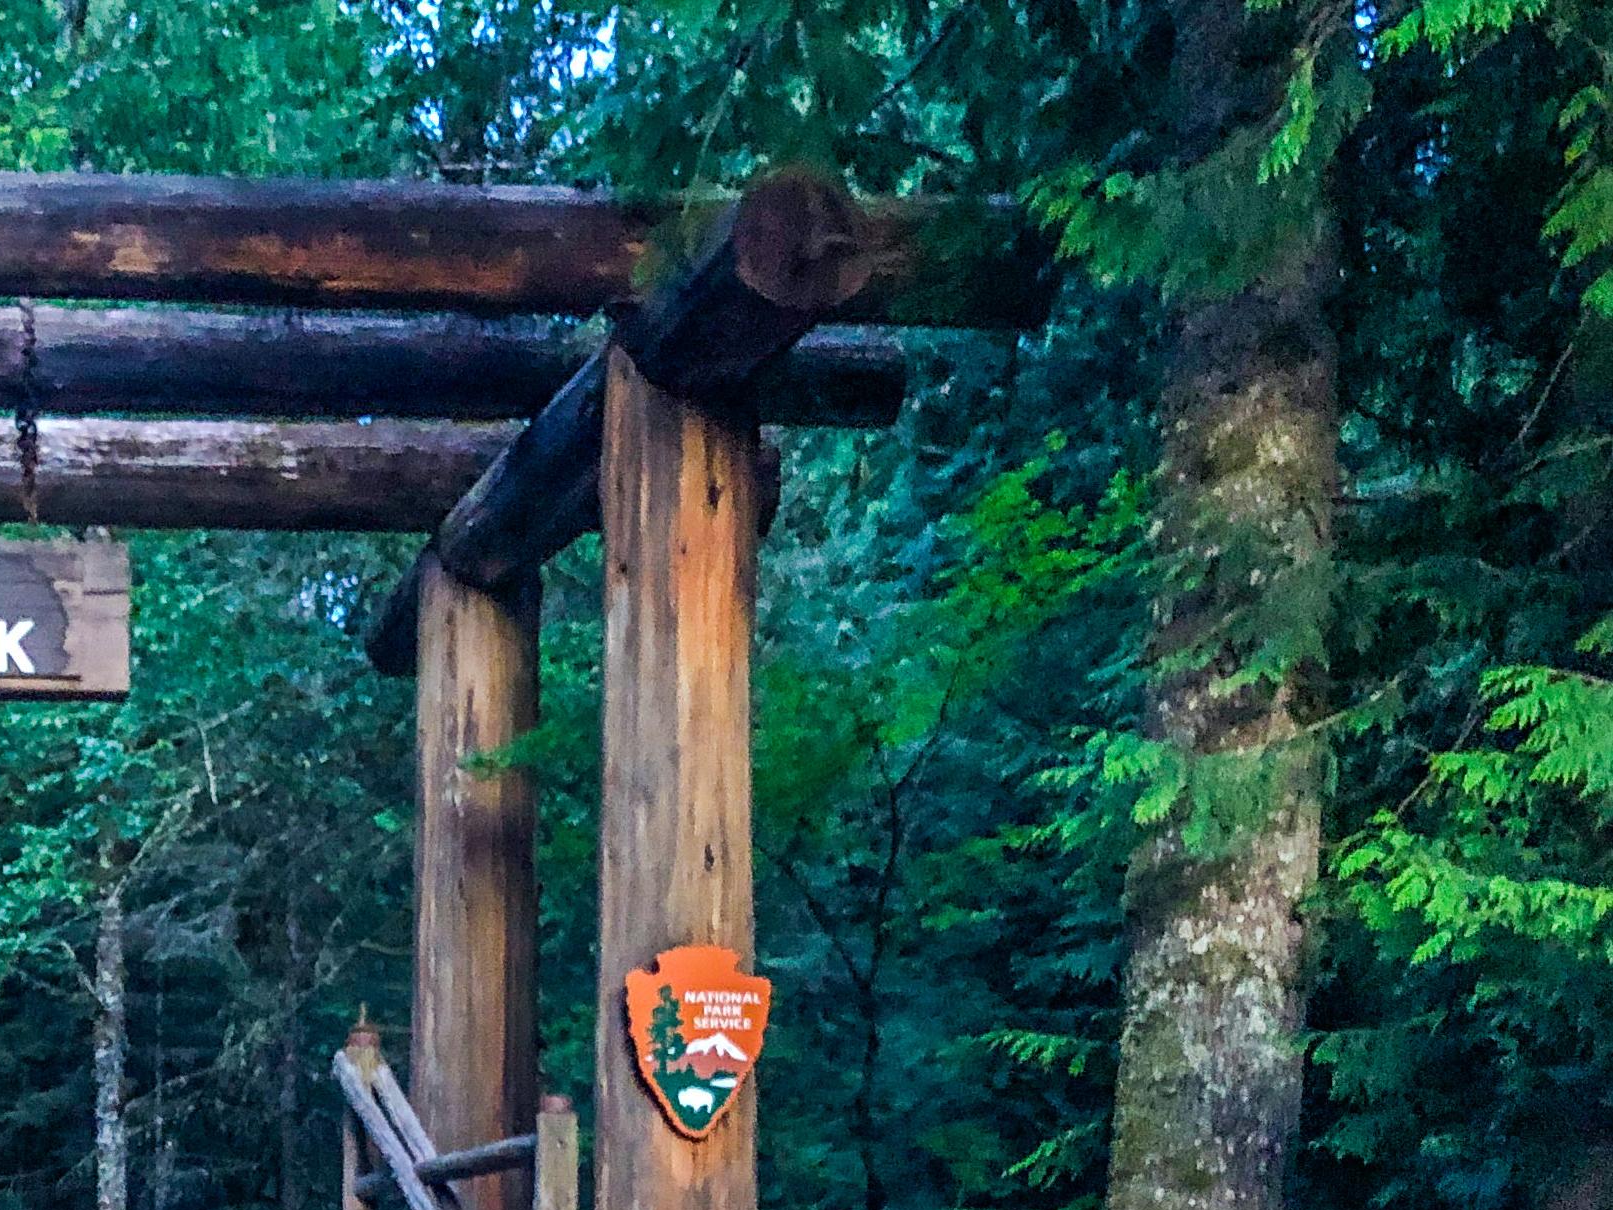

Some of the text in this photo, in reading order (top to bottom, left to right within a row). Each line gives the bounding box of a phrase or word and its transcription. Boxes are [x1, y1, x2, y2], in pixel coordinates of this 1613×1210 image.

[684, 991, 761, 1005] NATIONAL
[703, 1005, 742, 1016] PARK
[693, 1018, 752, 1030] SERVICE
